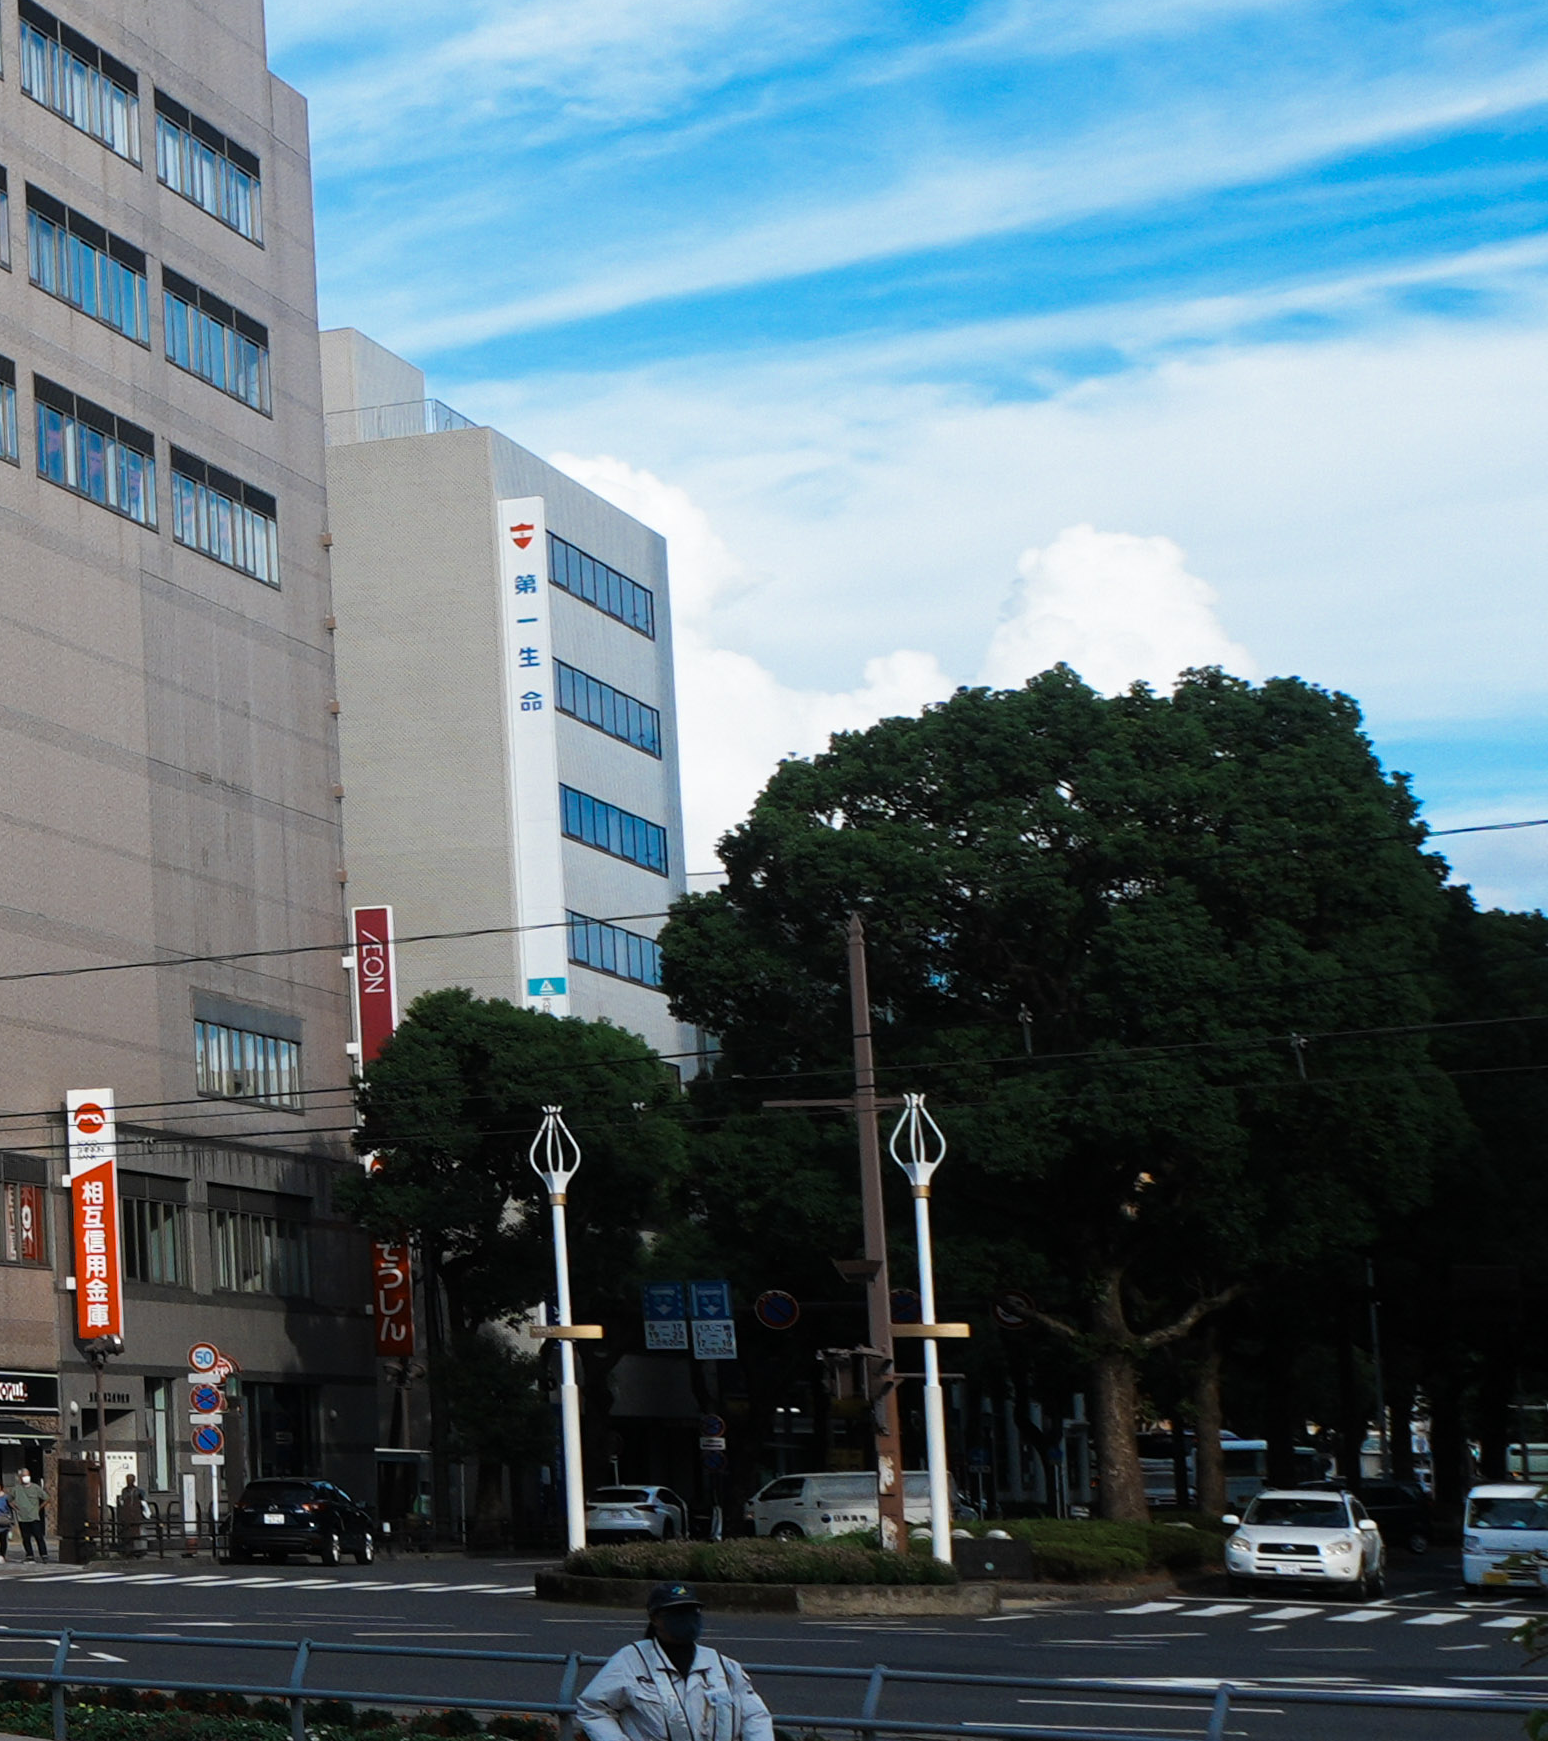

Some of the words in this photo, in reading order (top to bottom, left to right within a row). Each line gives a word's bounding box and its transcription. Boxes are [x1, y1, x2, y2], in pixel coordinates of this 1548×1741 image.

[514, 574, 543, 712] 第一生命
[81, 1180, 110, 1328] 相互信用金庫
[194, 1350, 213, 1365] 50
